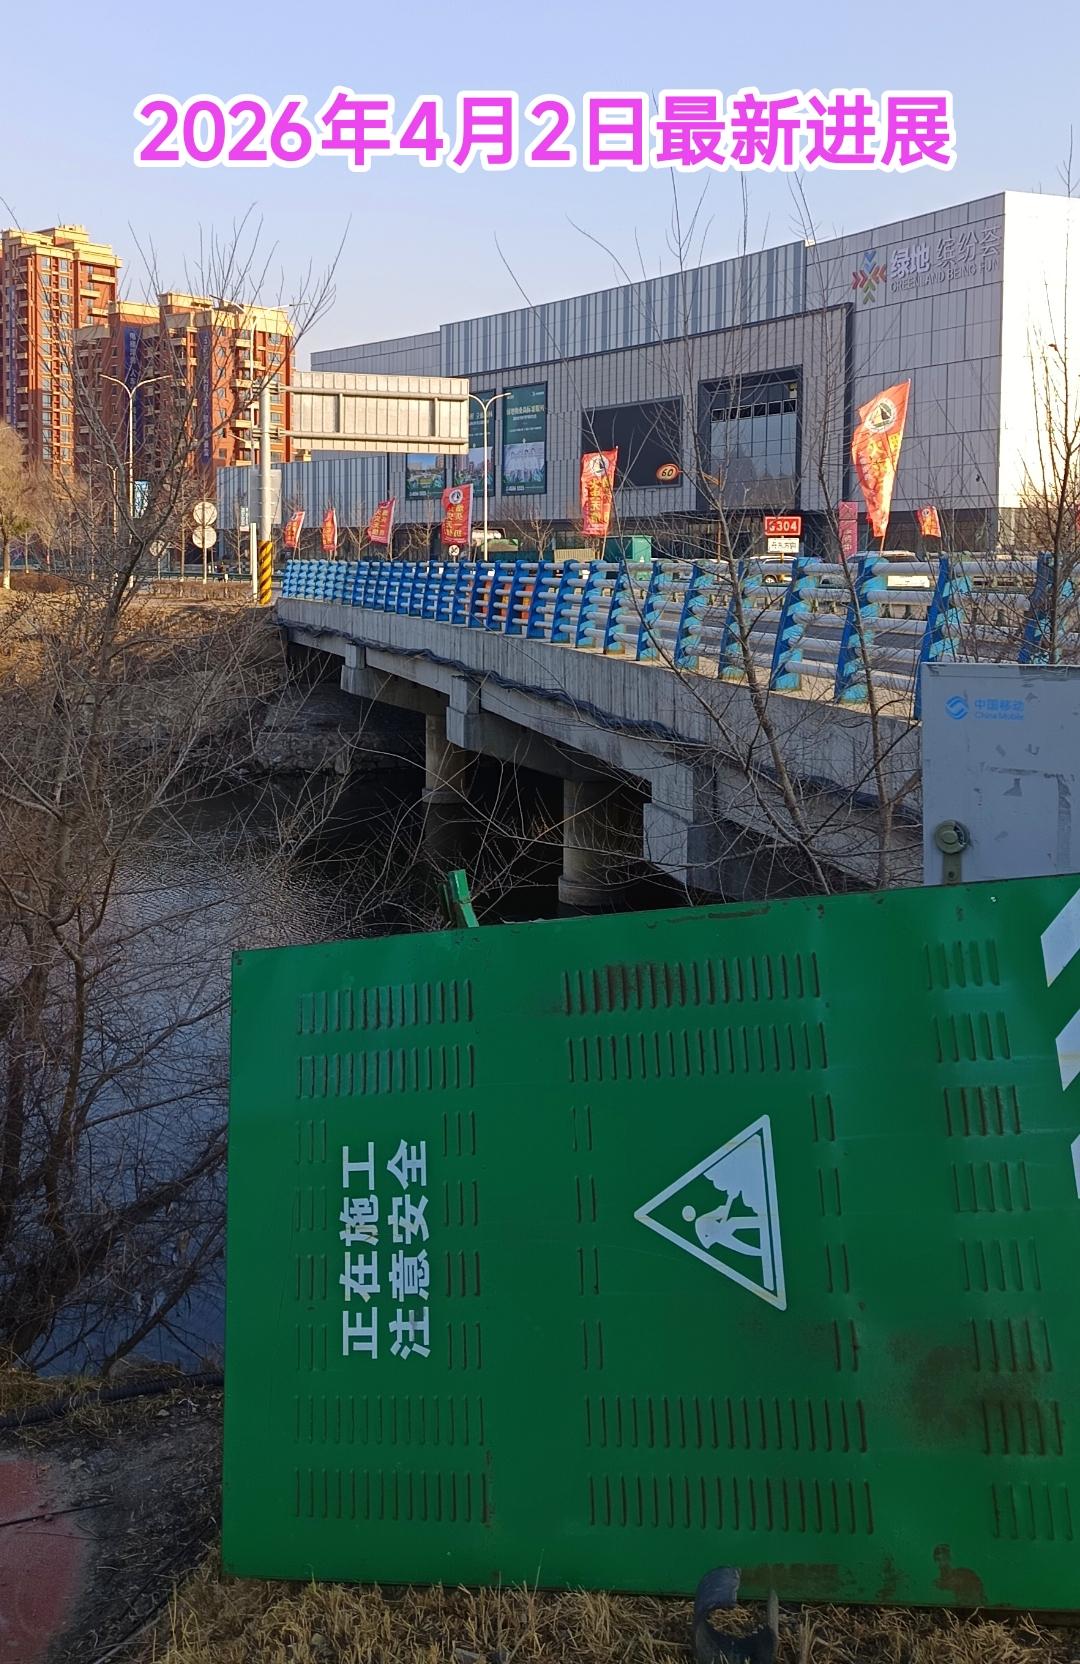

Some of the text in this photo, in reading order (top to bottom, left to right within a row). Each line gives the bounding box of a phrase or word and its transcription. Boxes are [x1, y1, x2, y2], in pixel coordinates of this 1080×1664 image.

[889, 243, 930, 280] 绿地
[890, 270, 946, 293] GREENLAND
[947, 263, 977, 281] BEING
[661, 468, 674, 477] 60
[974, 698, 1024, 711] 中国移动
[339, 1141, 381, 1360] 正在施工
[386, 1139, 431, 1361] 注意安全
